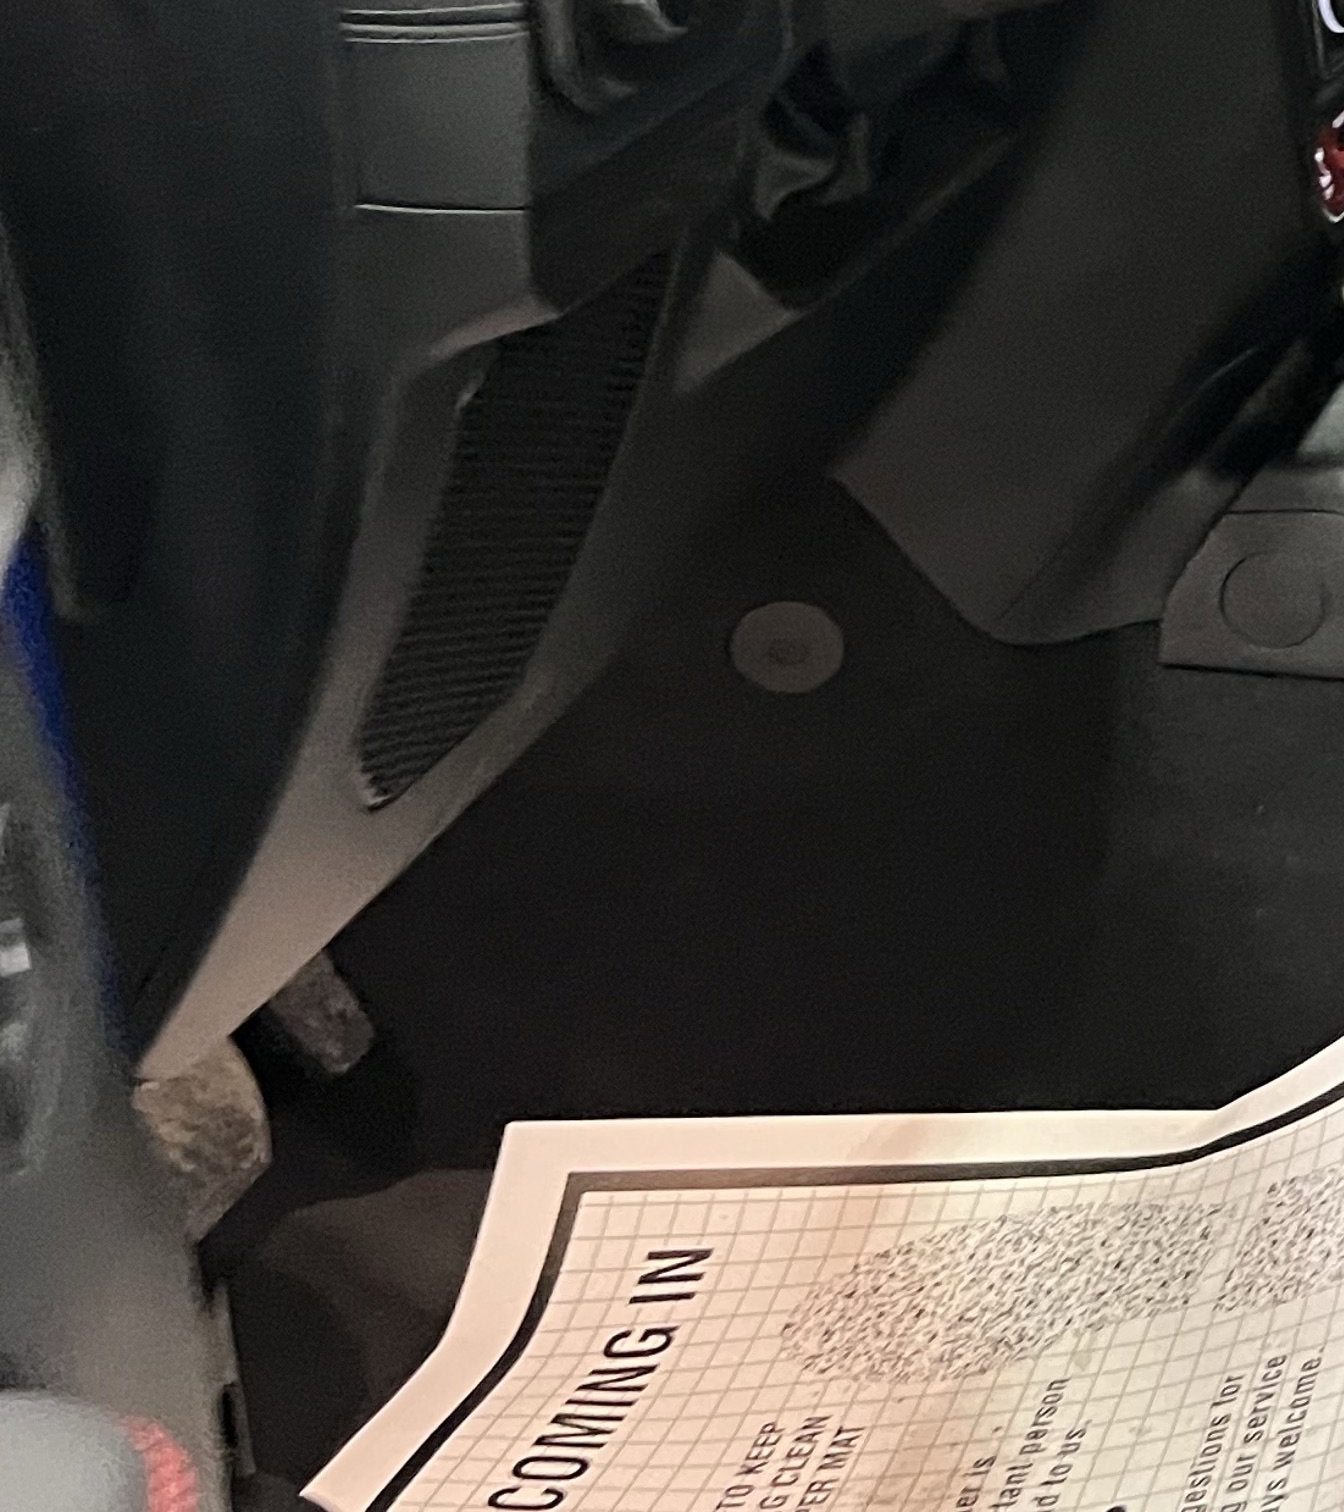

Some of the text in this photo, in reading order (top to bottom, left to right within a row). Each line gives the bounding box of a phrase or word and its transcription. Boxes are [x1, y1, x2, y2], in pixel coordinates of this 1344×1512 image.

[488, 1247, 715, 1510] COMING IN
[1225, 1453, 1258, 1494] our
[1243, 1354, 1288, 1445] service
[714, 1421, 787, 1512] TO KEEP
[770, 1414, 834, 1488] CLEAN
[816, 1425, 866, 1472] MAT
[988, 1376, 1072, 1512] tant person
[1038, 1463, 1074, 1487] to
[1181, 1412, 1232, 1512] gestions
[955, 1486, 983, 1512] er
